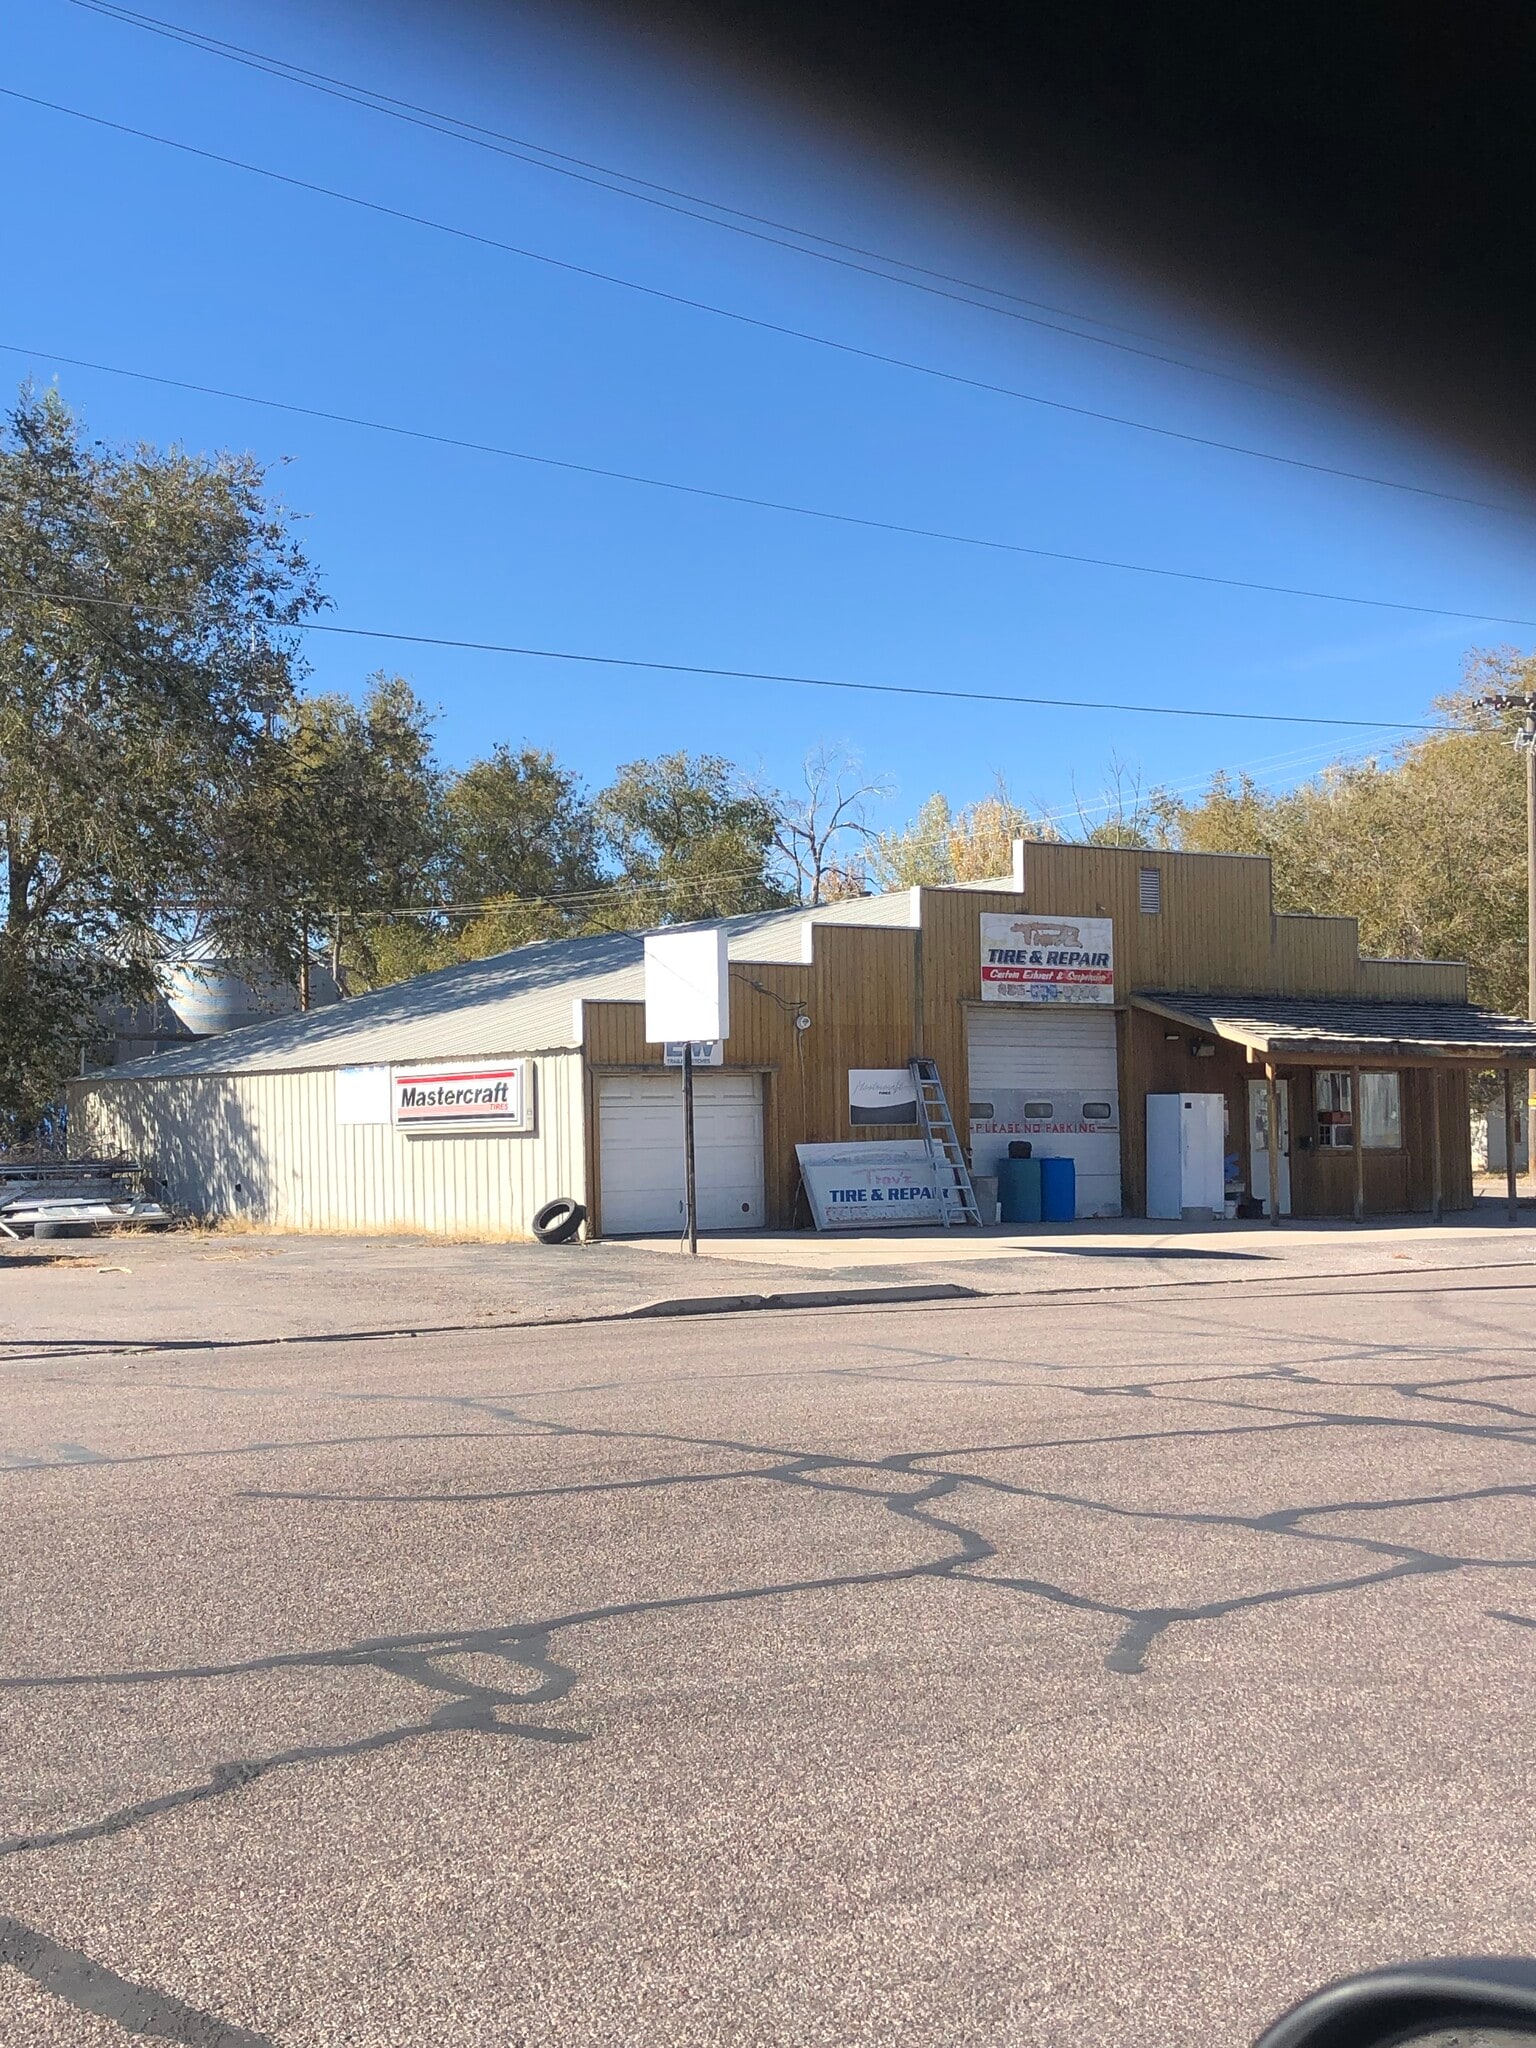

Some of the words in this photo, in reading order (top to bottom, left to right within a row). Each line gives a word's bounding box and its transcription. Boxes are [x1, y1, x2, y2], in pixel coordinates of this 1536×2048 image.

[988, 949, 1027, 966] TIRE
[1029, 951, 1042, 966] &
[1046, 951, 1110, 968] REPAIR
[990, 969, 1020, 979] Custom
[401, 1082, 508, 1107] Mastercraft
[490, 1103, 508, 1111] TIRES
[976, 1123, 1020, 1133] PLEASE
[1024, 1124, 1041, 1133] NO
[1045, 1123, 1096, 1133] PARKING
[829, 1189, 867, 1203] TIRE
[870, 1188, 884, 1201] &
